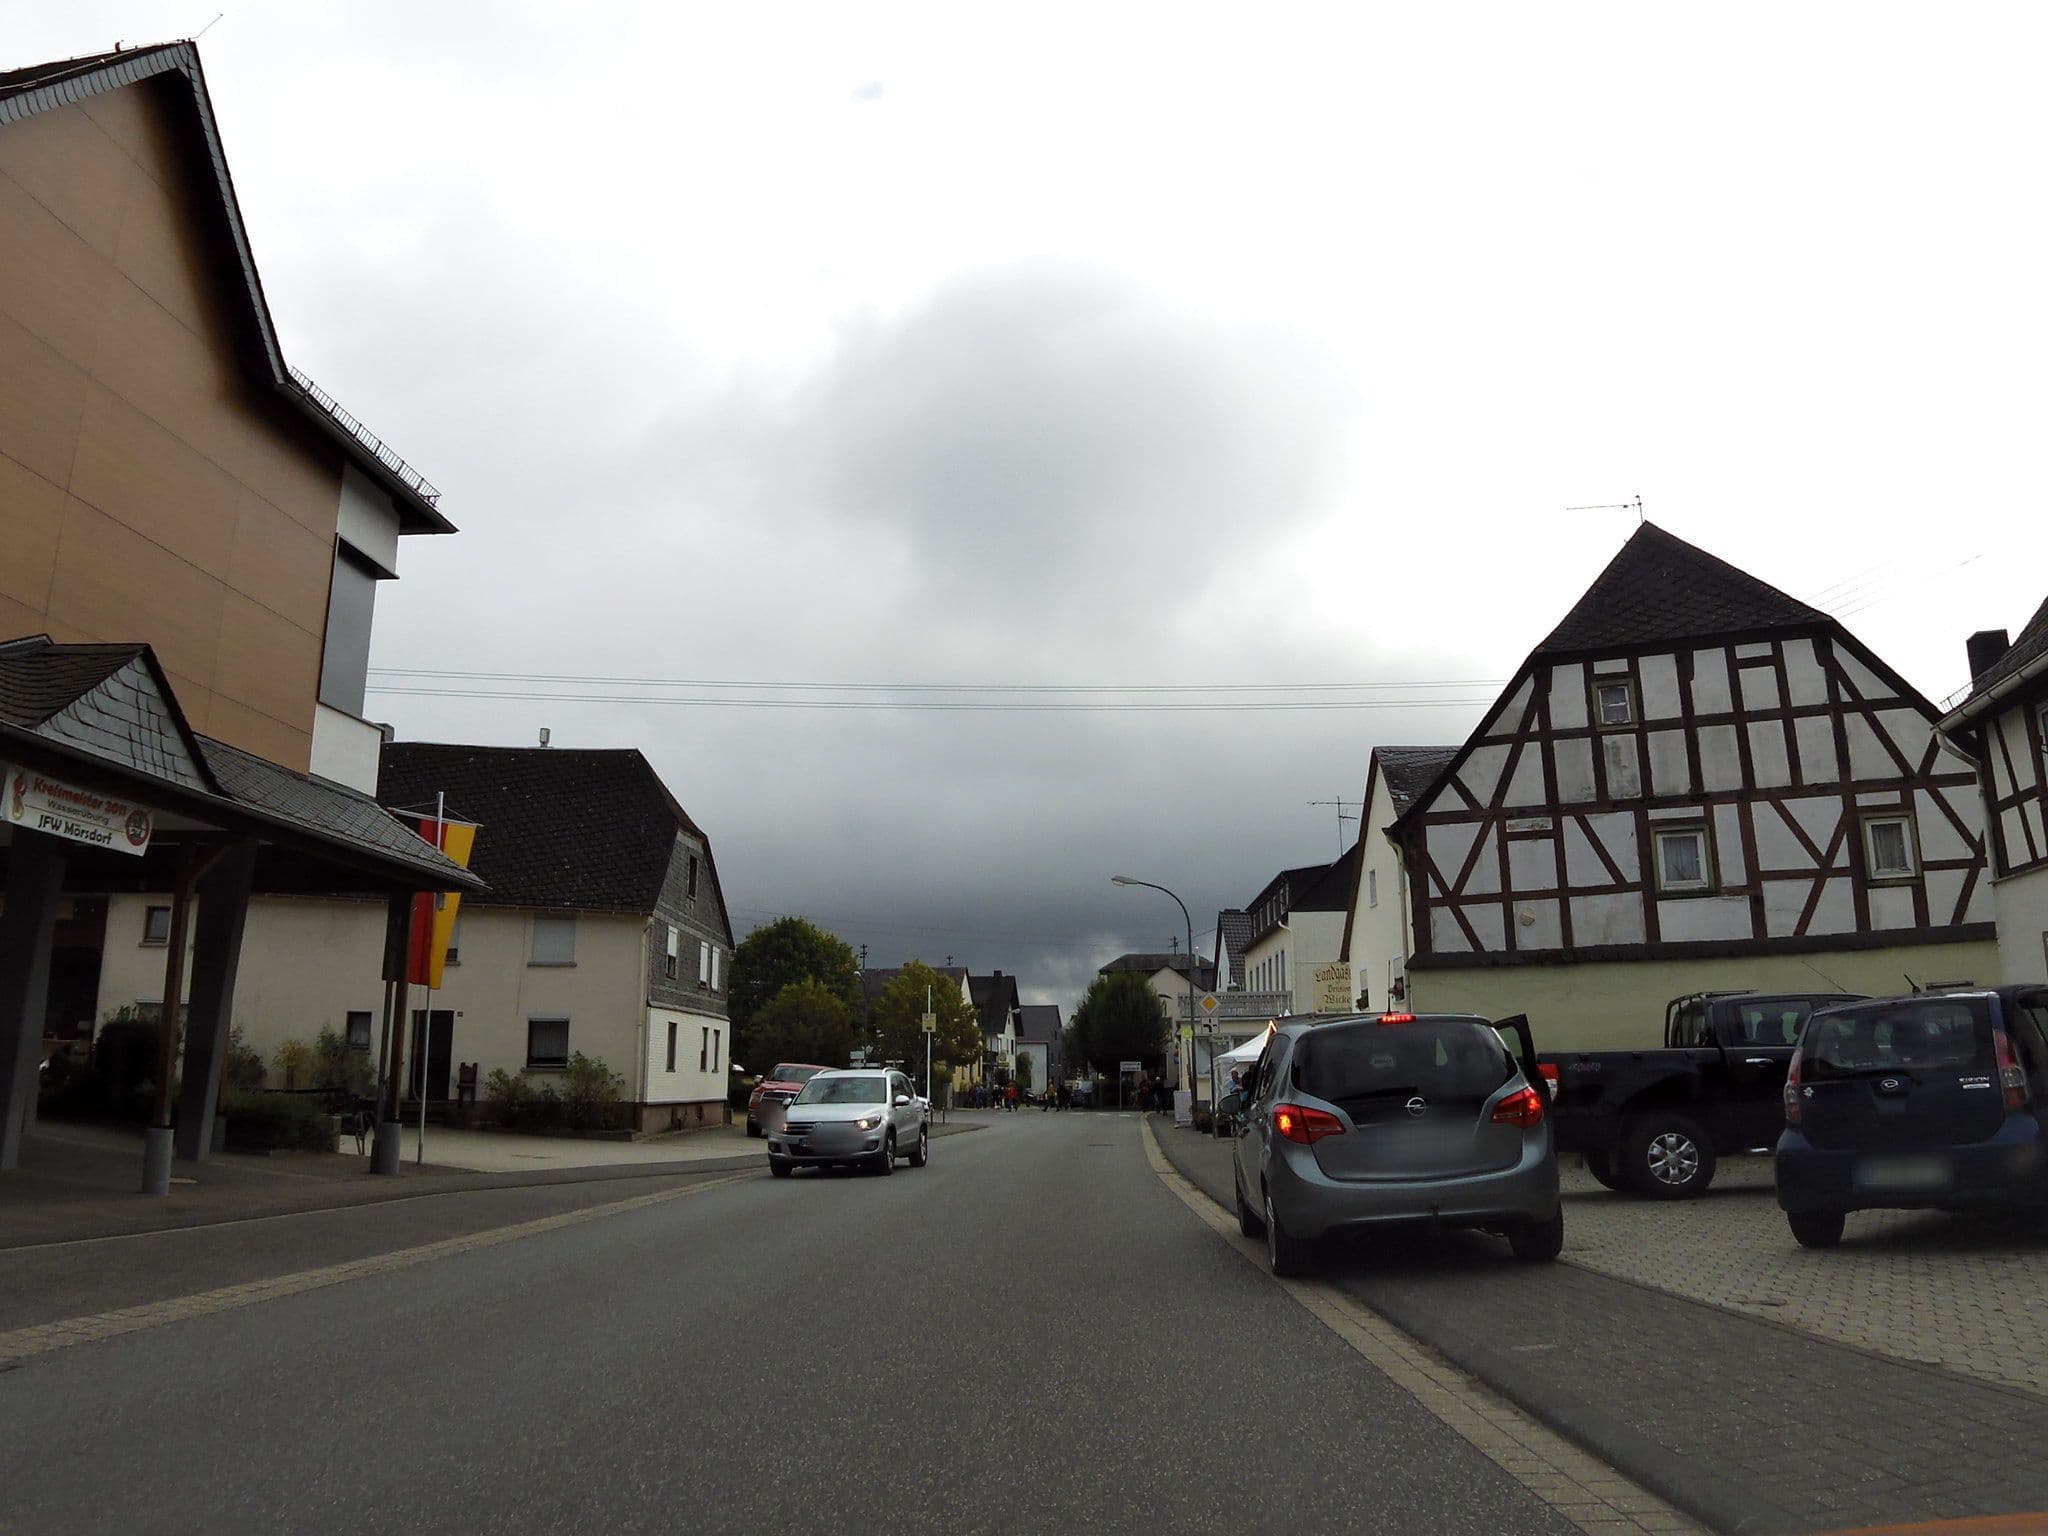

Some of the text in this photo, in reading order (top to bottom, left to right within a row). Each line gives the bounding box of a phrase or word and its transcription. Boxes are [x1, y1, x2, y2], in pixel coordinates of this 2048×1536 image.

[33, 777, 128, 816] Kreismeister 2011
[38, 814, 112, 845] JFW Mörsdorf
